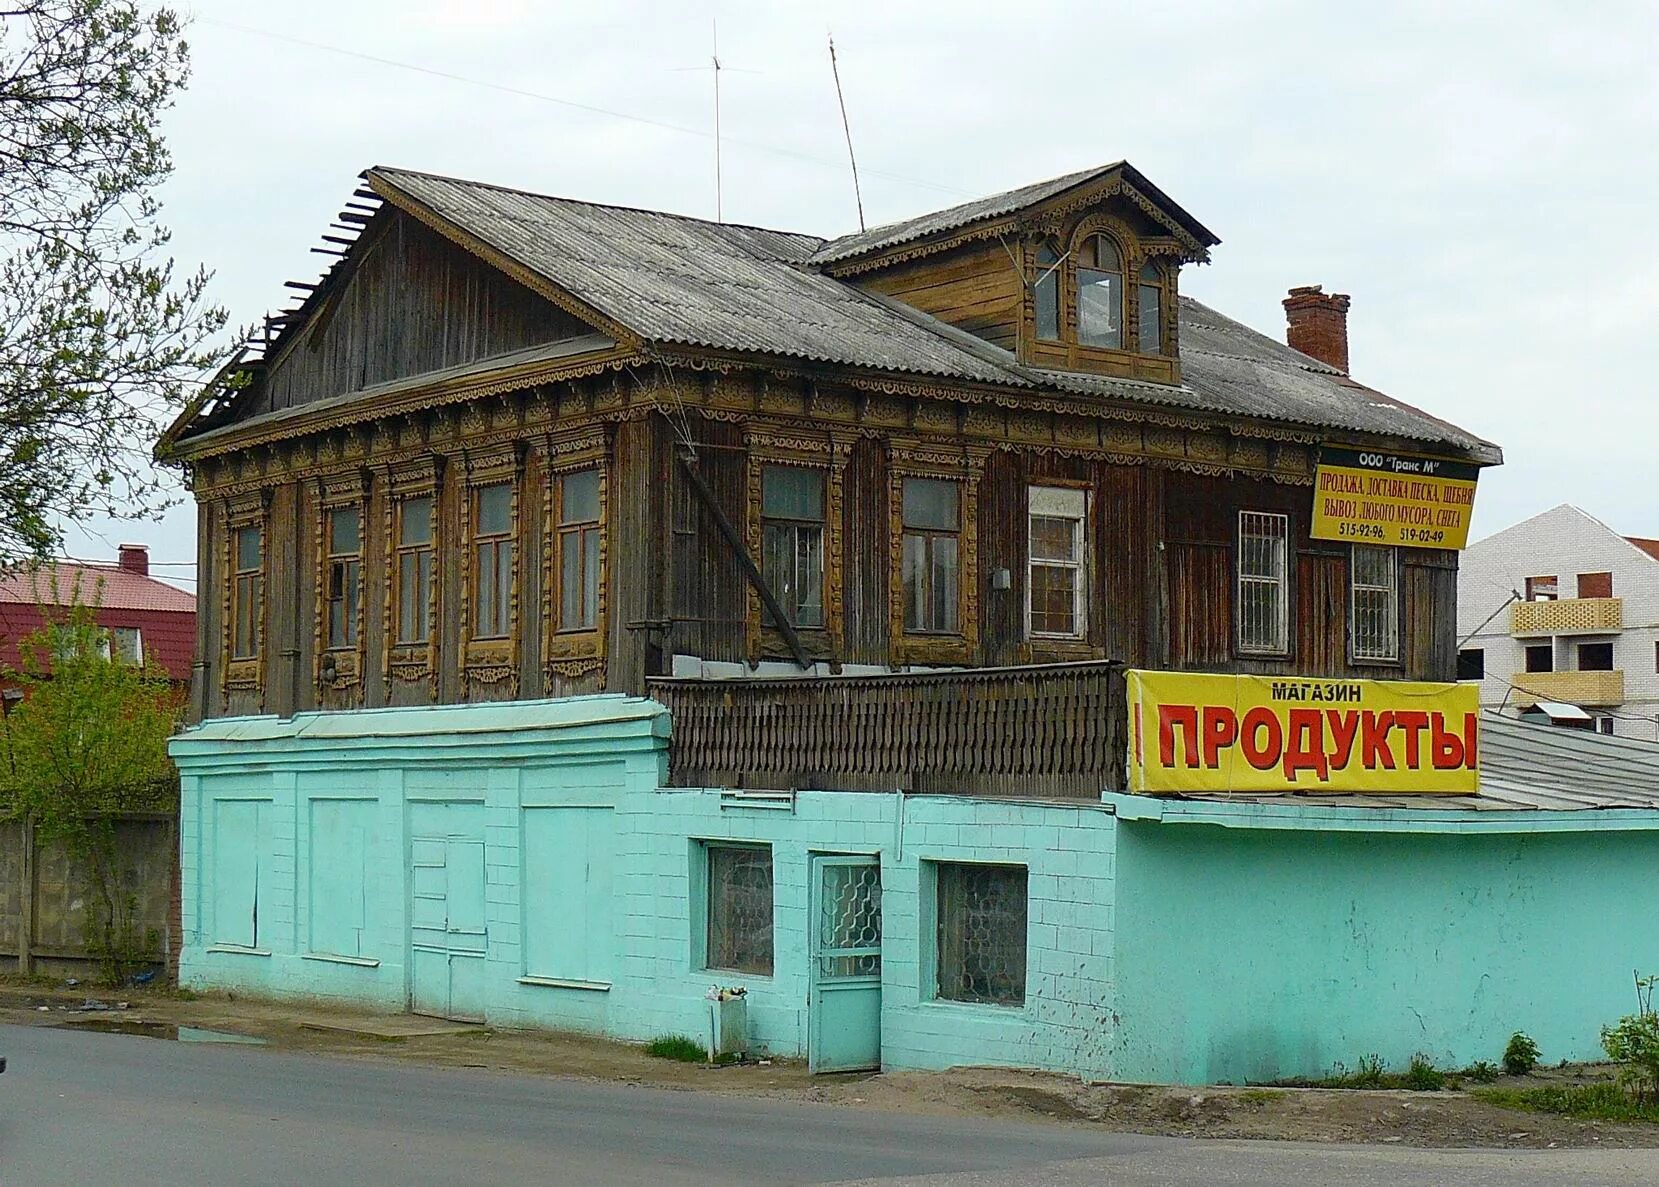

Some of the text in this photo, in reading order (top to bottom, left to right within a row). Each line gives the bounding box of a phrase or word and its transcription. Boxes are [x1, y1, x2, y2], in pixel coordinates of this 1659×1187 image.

[1359, 453, 1384, 467] ООО
[1367, 477, 1408, 500] ДОСТАВКА
[1324, 498, 1357, 519] ВЫВОЗ
[1359, 501, 1395, 523] ЛЮБОГО
[1436, 509, 1460, 529] СНЕГА
[1400, 528, 1444, 543] 519-02-49
[1272, 682, 1361, 702] МАГАЗИН
[1158, 704, 1477, 782] ПРОДУКТЫ
